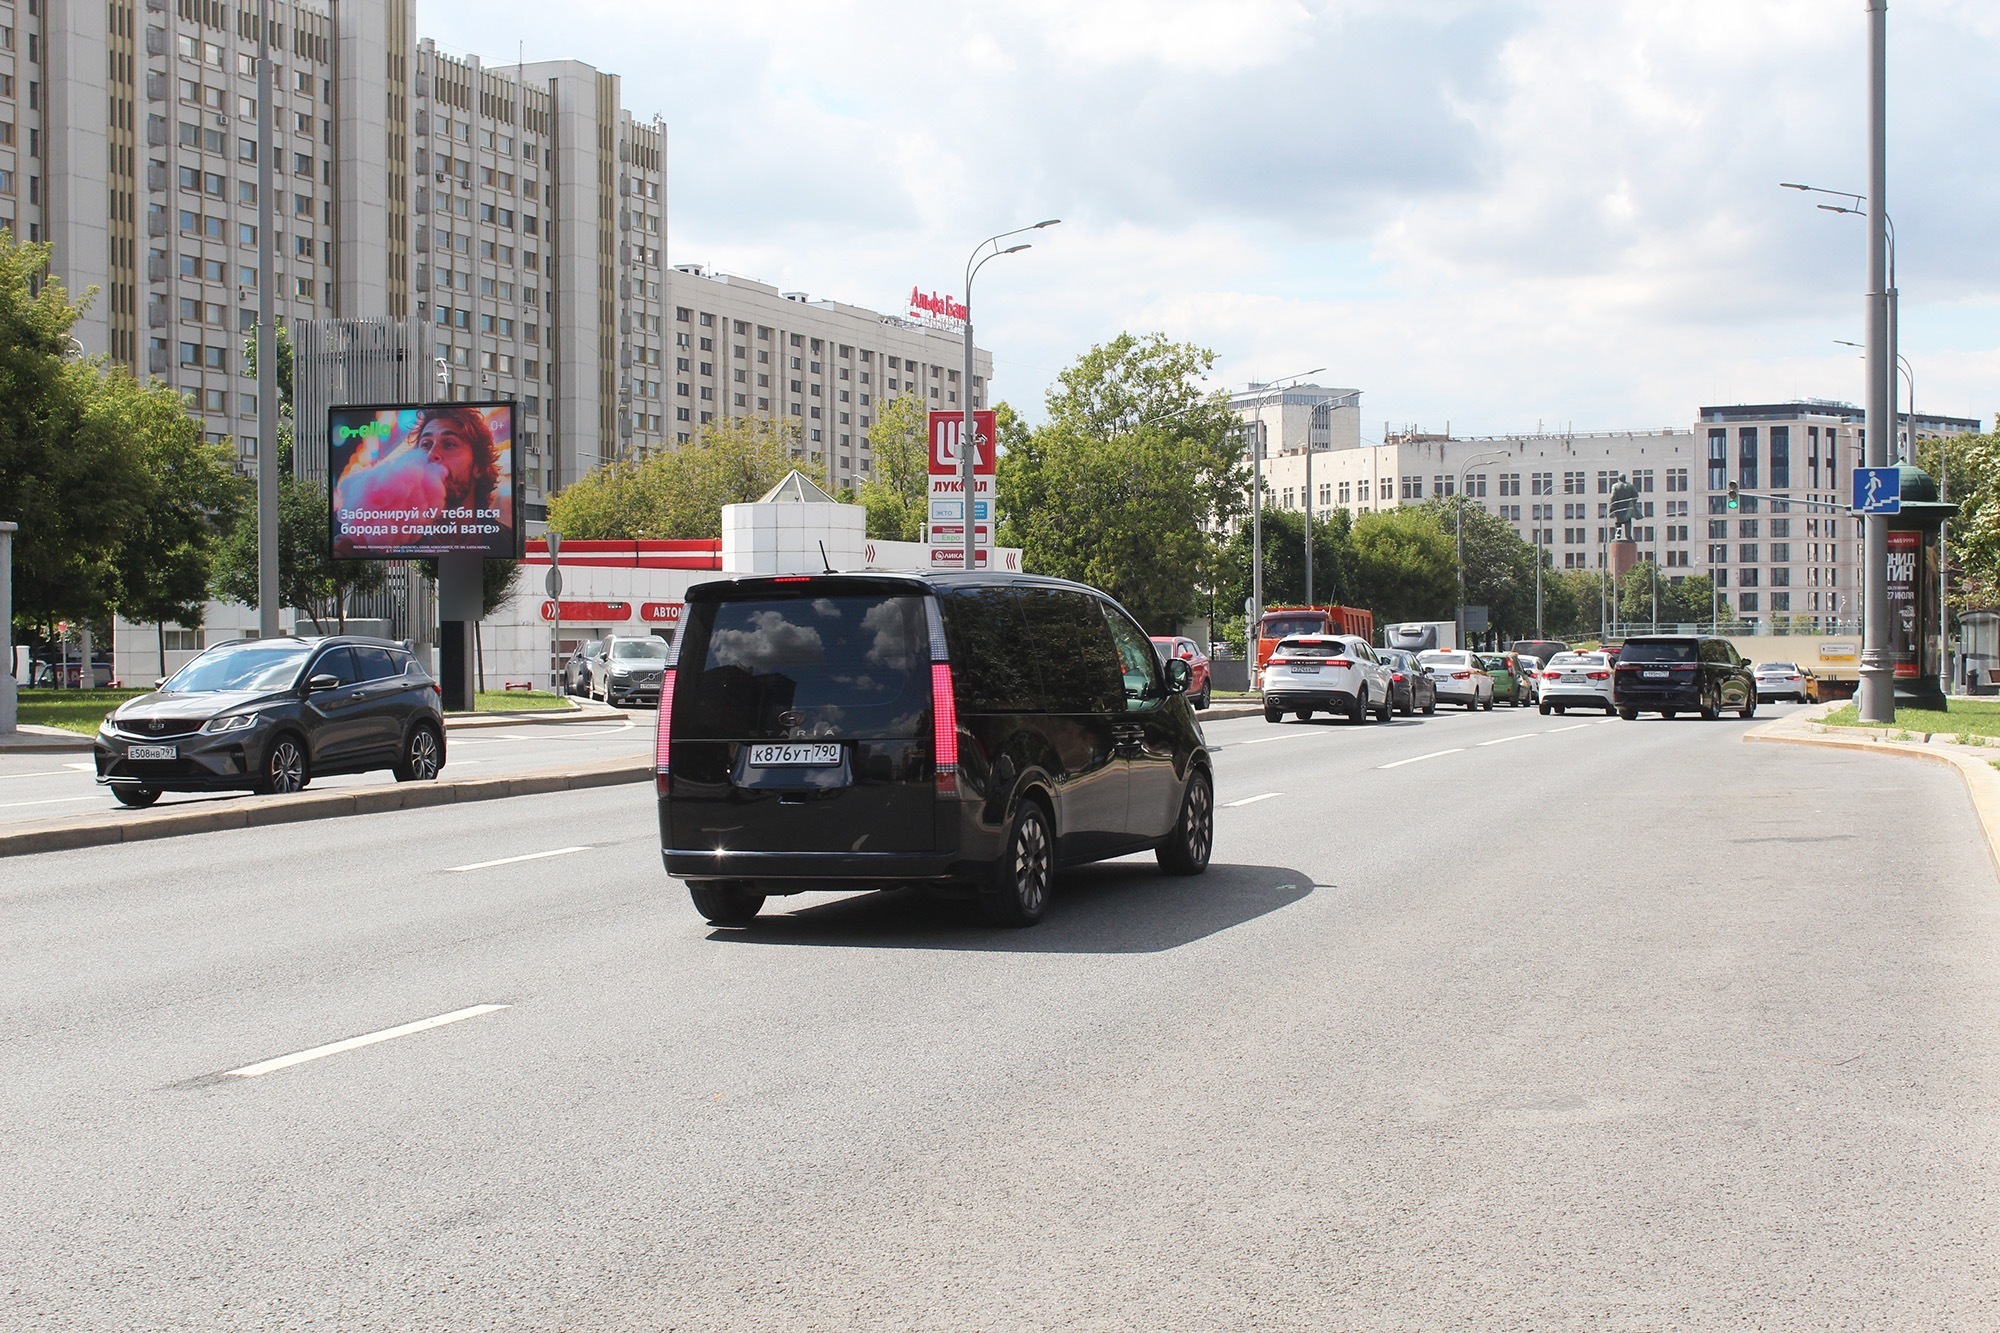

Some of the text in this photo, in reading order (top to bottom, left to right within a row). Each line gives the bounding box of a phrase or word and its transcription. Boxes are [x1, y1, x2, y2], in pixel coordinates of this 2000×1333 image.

[910, 286, 945, 318] Альфа
[490, 420, 504, 431] 0+
[341, 507, 500, 521] Забронируй «У тебя вся
[340, 522, 500, 536] борода в сладкой вате»
